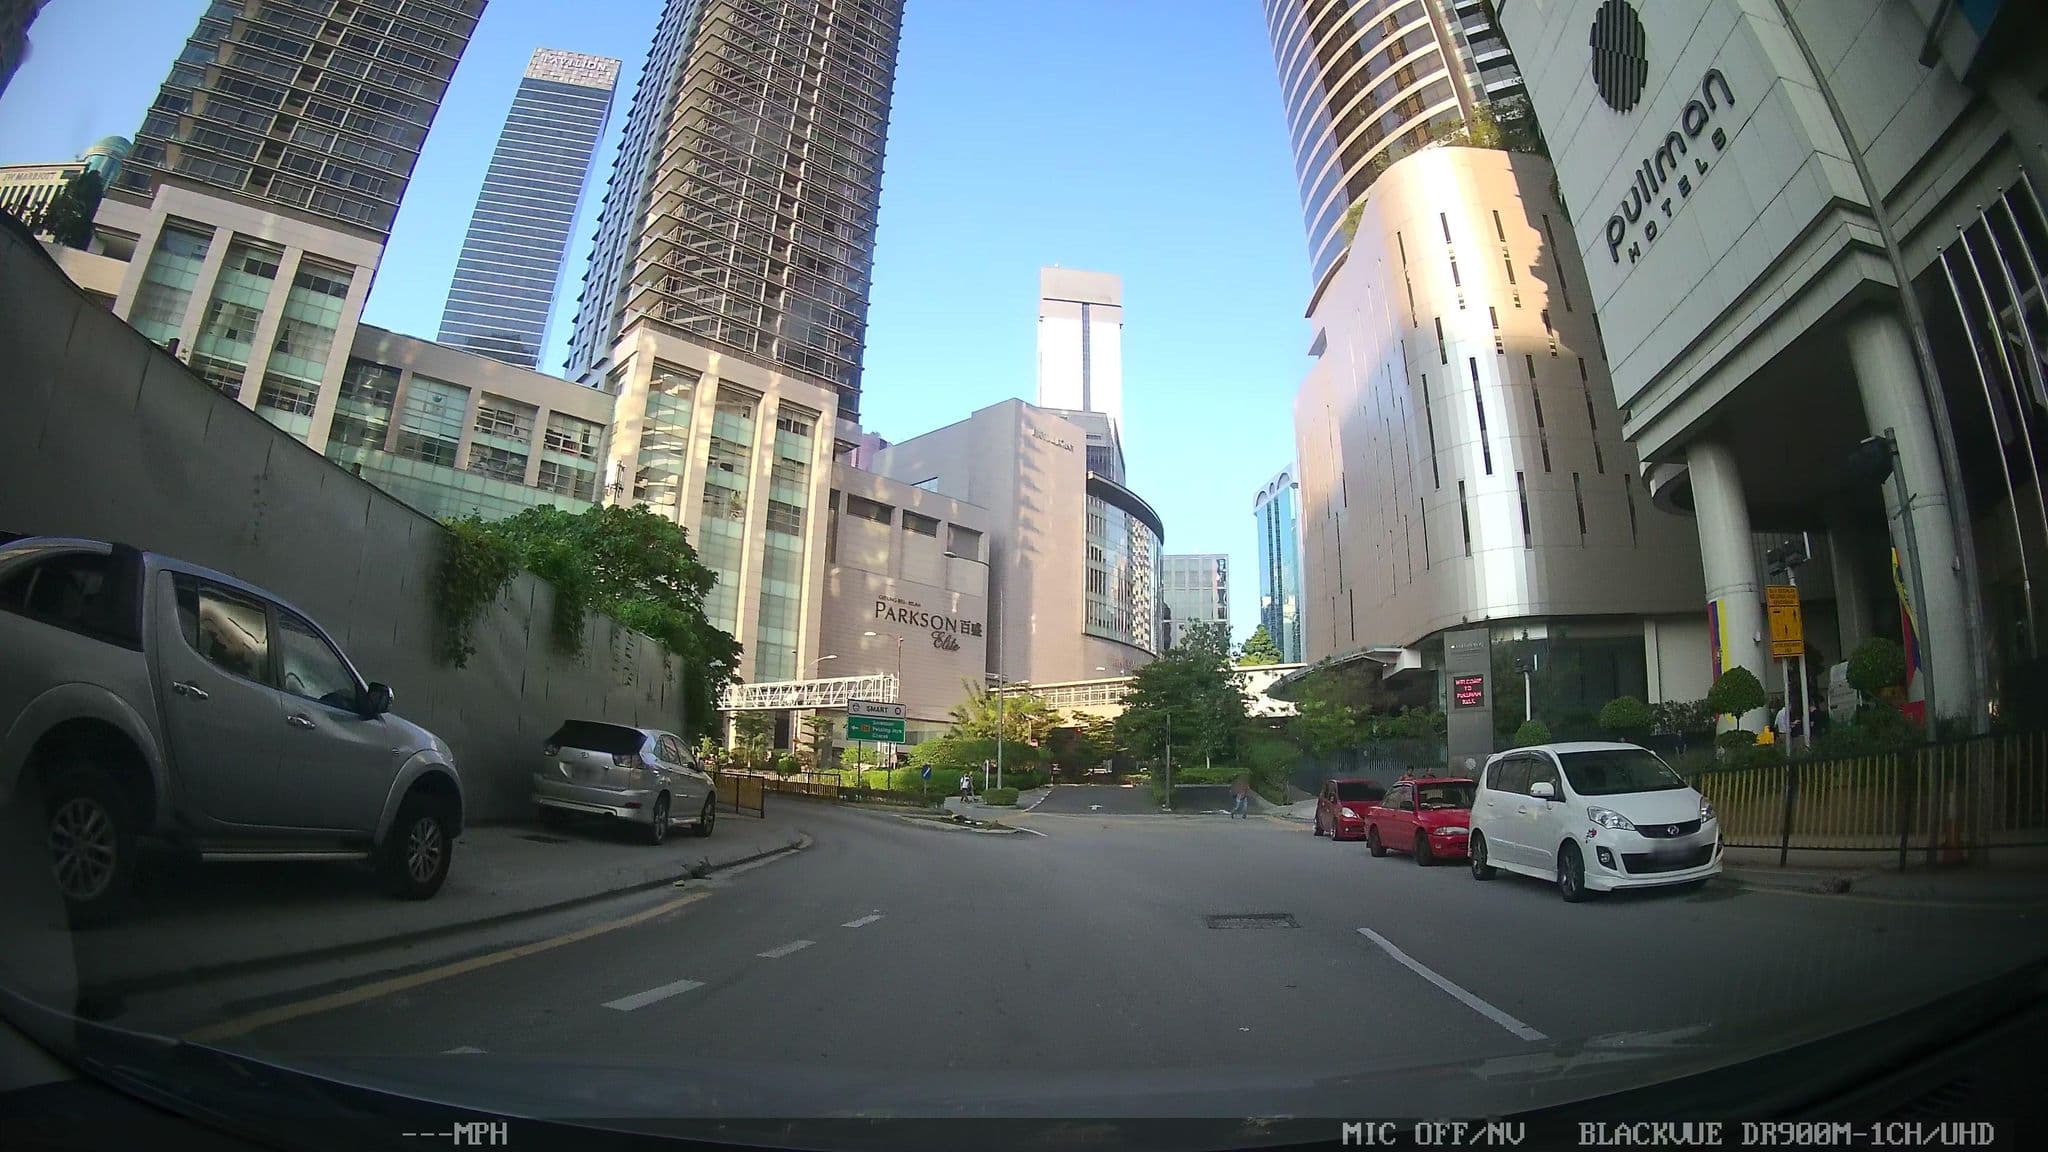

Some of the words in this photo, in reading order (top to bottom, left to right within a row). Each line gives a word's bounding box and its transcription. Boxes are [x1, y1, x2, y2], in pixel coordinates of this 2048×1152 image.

[541, 52, 607, 71] PAVILION
[1606, 68, 1736, 264] pullman
[1628, 127, 1727, 264] HOTELS
[875, 601, 958, 633] PARKSON
[960, 619, 983, 638] 百盛
[931, 631, 961, 652] Elite
[1456, 691, 1482, 699] PULLMAN
[866, 705, 889, 713] SMART
